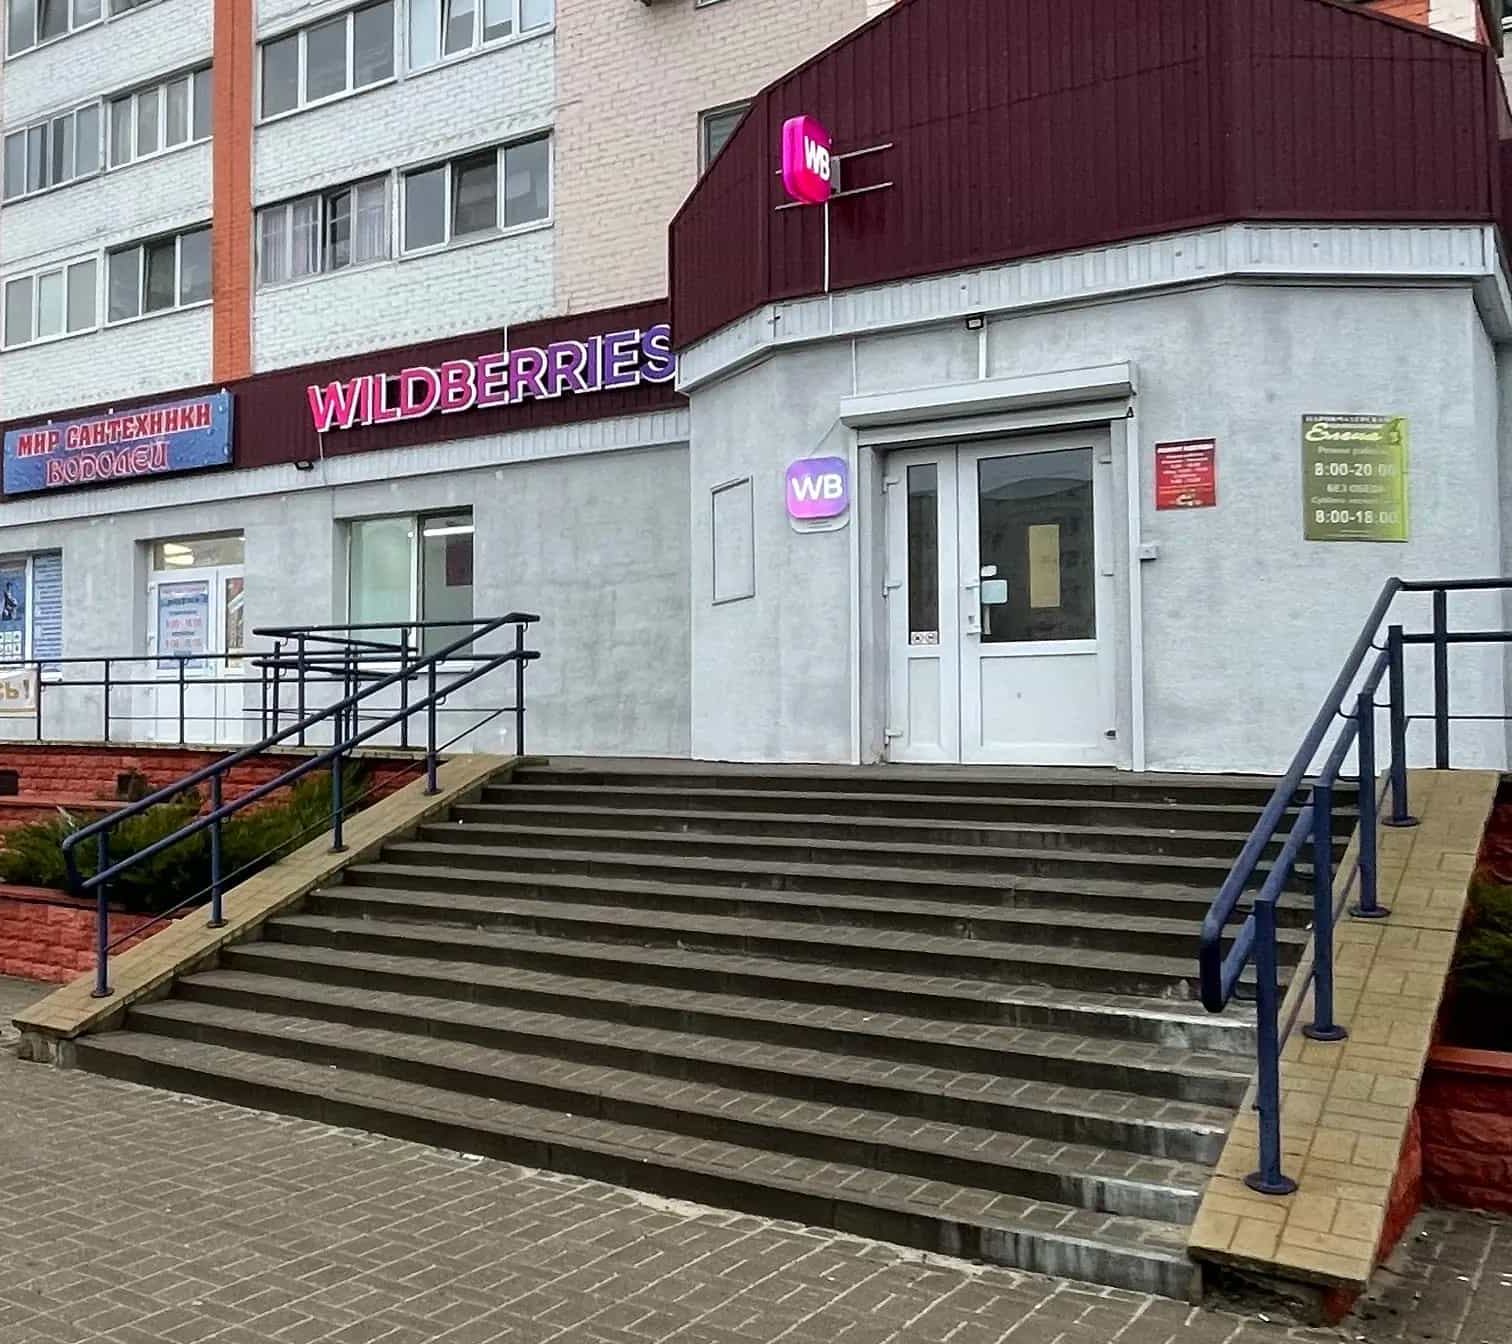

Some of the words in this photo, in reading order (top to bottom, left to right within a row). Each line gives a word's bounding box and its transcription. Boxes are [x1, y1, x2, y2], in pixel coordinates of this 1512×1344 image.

[804, 135, 830, 182] WB
[306, 324, 679, 432] WILDBERRIES
[17, 430, 60, 458] МИР
[65, 403, 213, 450] САНТЕХНИКИ
[46, 440, 170, 487] ВОДОЛЕЙ
[792, 473, 843, 502] WB
